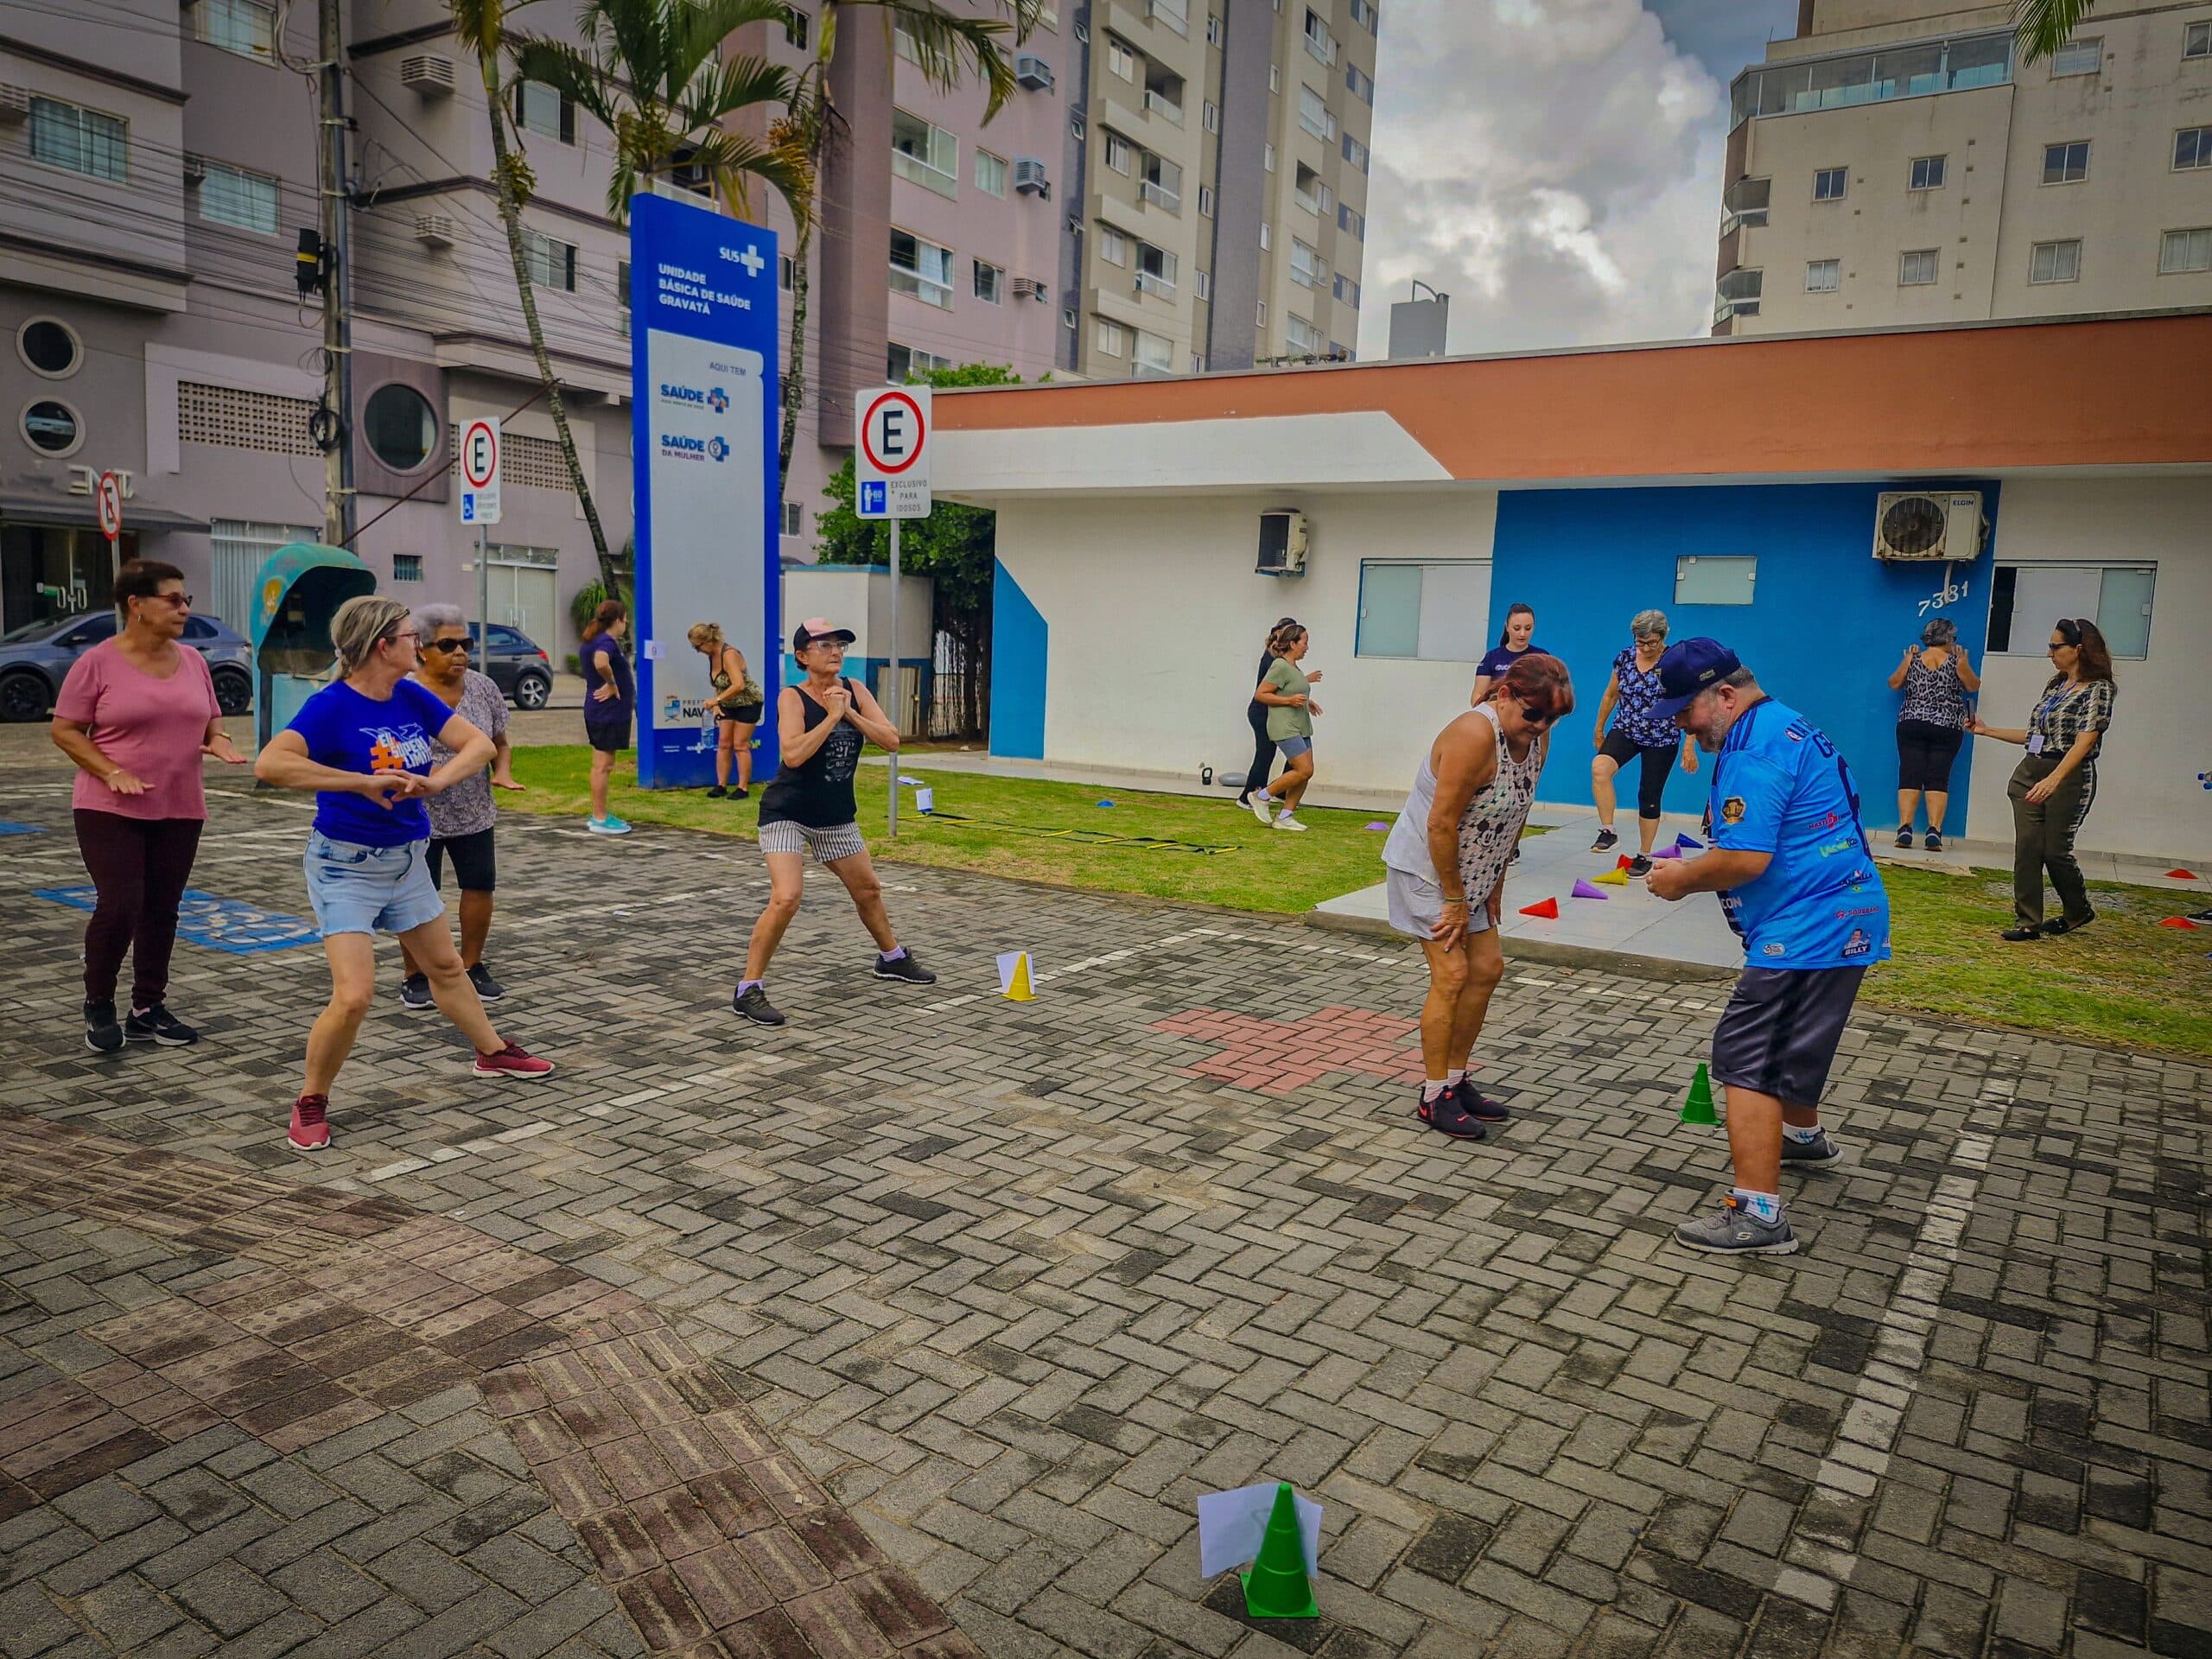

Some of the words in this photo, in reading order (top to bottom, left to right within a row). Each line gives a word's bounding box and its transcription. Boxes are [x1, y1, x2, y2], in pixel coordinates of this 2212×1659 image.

[719, 246, 740, 263] SUS
[658, 263, 707, 285] UNIDADE
[658, 277, 699, 297] BÁSICA
[701, 288, 715, 302] DE
[716, 292, 751, 310] SAÚDE
[659, 293, 711, 315] GRAVATÁ
[709, 361, 728, 372] AQUI
[730, 365, 747, 377] TEM
[661, 384, 704, 404] SAÚDE
[883, 410, 904, 455] E
[662, 435, 705, 452] SAÚDE
[474, 436, 485, 474] E
[674, 451, 705, 462] MULHER
[891, 480, 927, 488] EXCLUSIVO
[896, 504, 921, 512] IDOSOS
[1918, 581, 1968, 617] 7381
[1844, 944, 1868, 957] BILLY
